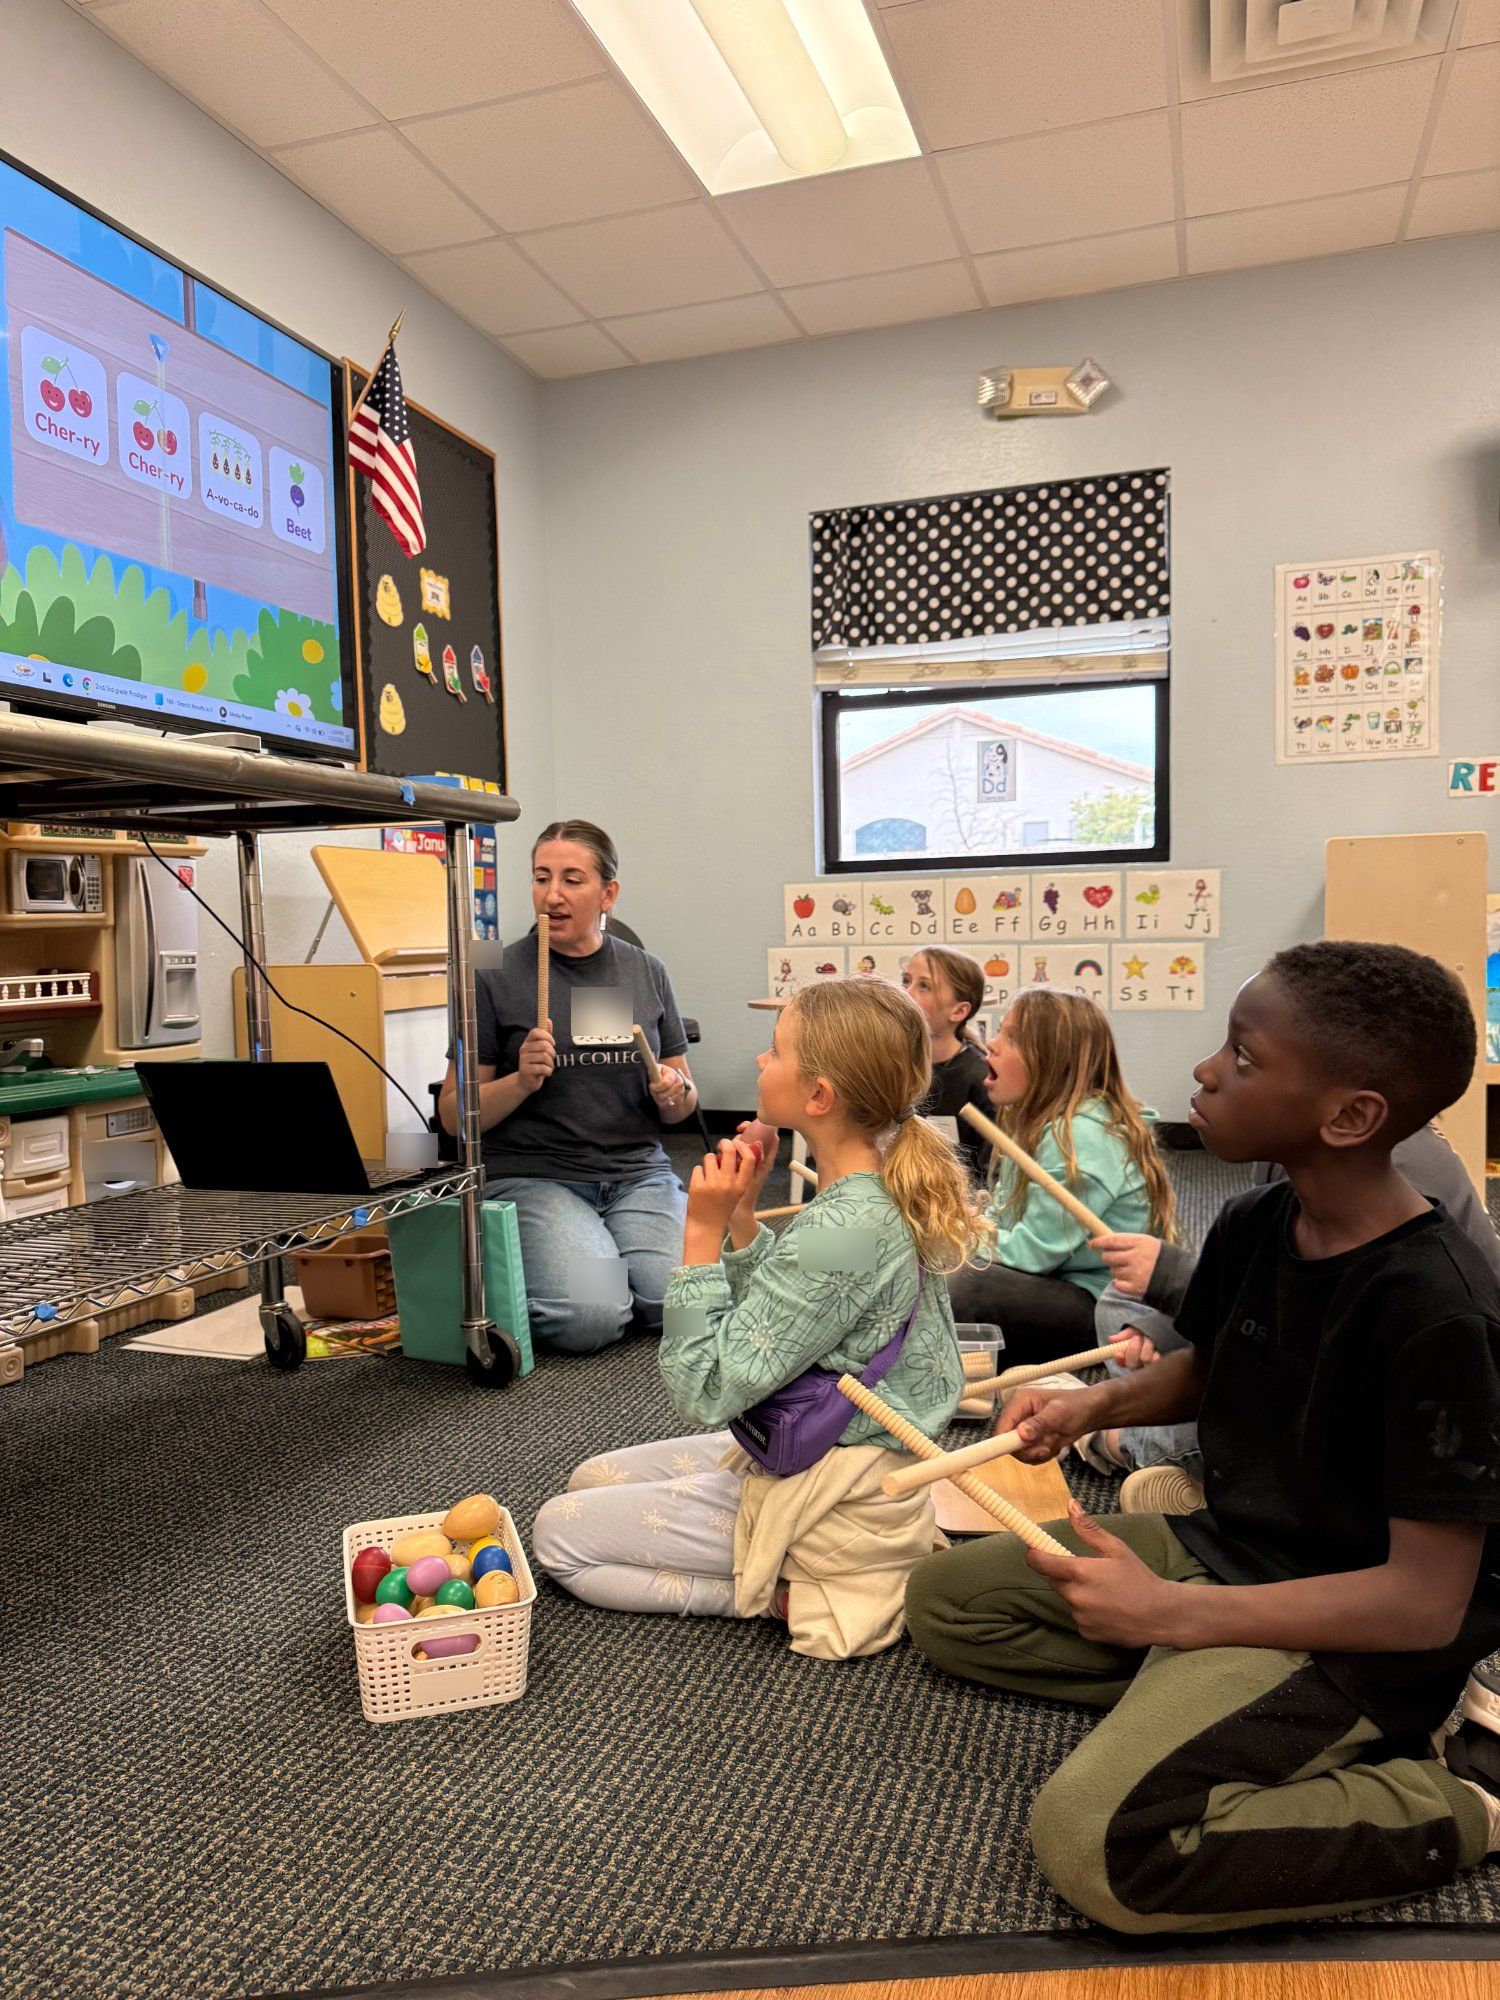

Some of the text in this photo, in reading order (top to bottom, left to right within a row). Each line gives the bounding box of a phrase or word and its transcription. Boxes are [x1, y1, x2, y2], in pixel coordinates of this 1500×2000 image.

[35, 412, 101, 457] Cher-ry
[128, 451, 185, 491] Cher-ry
[206, 487, 259, 519] A-vo-ca-do
[286, 517, 313, 542] Beet
[982, 777, 1007, 794] Dd
